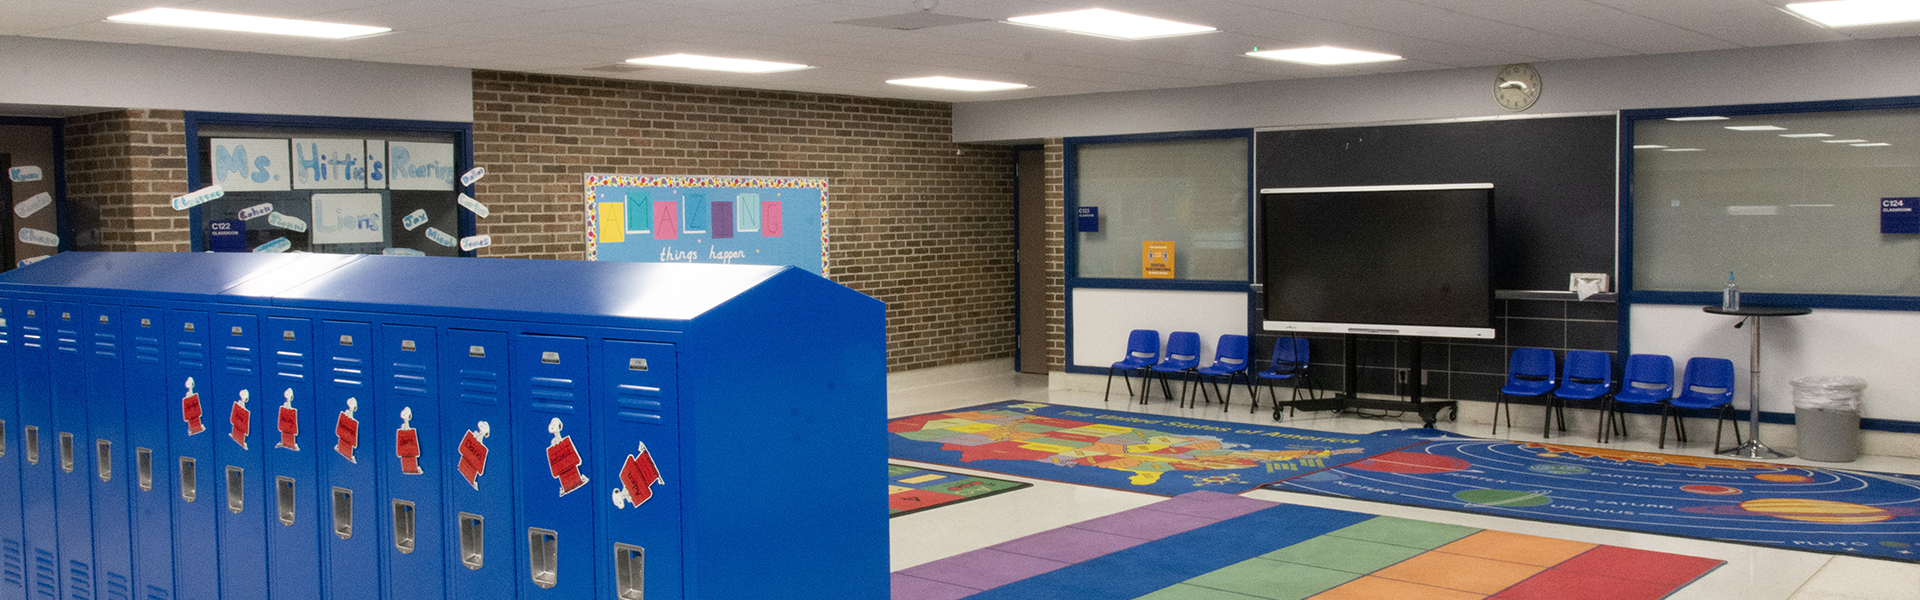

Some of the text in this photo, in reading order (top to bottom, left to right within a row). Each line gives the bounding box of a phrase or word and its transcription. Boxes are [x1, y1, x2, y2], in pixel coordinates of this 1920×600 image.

[215, 144, 281, 184] Ms.
[391, 146, 454, 185] Roaring
[315, 198, 379, 234] Lions
[600, 194, 782, 241] AMAZING
[212, 222, 231, 230] C122
[660, 245, 746, 264] things happen
[1162, 420, 1232, 432] States
[1260, 432, 1360, 444] America
[1622, 482, 1674, 490] MARS
[1550, 504, 1634, 515] URANUS
[1595, 500, 1674, 509] SATURN
